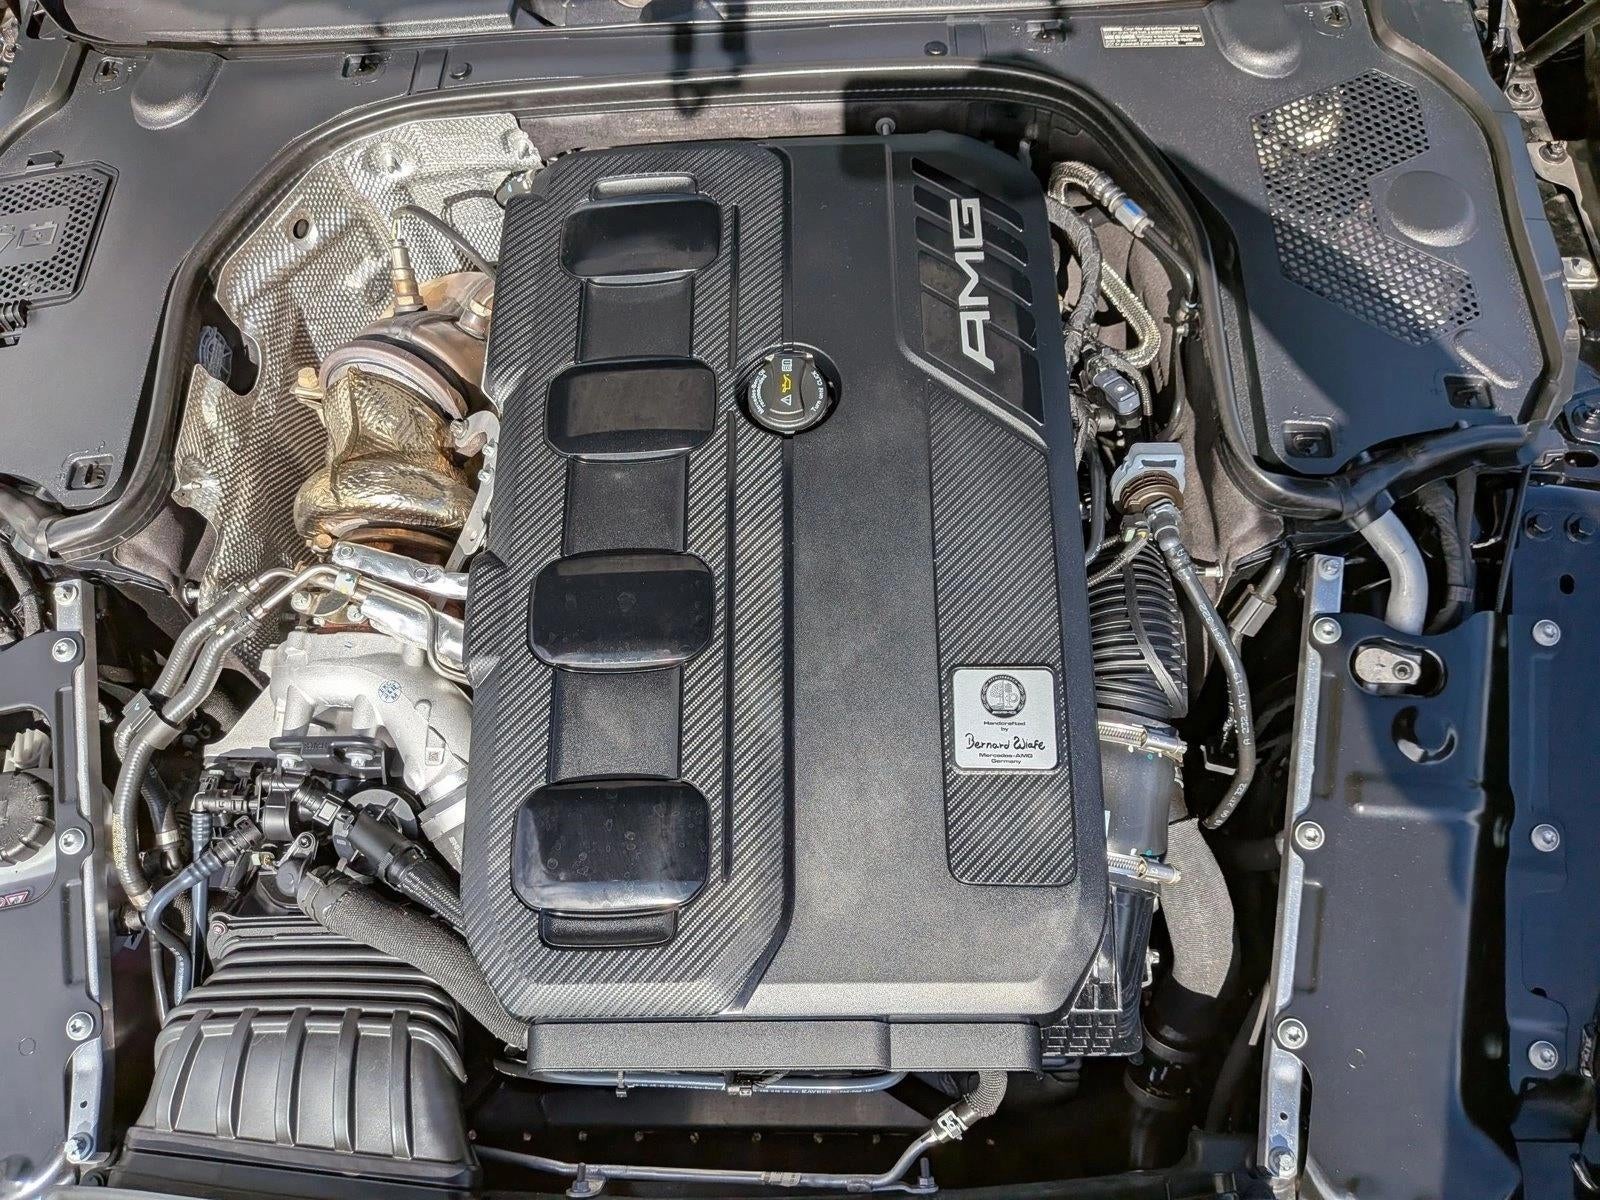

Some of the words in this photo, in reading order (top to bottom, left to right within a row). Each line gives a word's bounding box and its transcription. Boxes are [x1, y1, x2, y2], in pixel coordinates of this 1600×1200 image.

[950, 198, 995, 374] AMG
[811, 370, 823, 386] CLICK
[811, 400, 822, 412] Turn
[1241, 716, 1250, 734] 232
[965, 732, 1010, 750] Bernard
[1243, 738, 1251, 746] A
